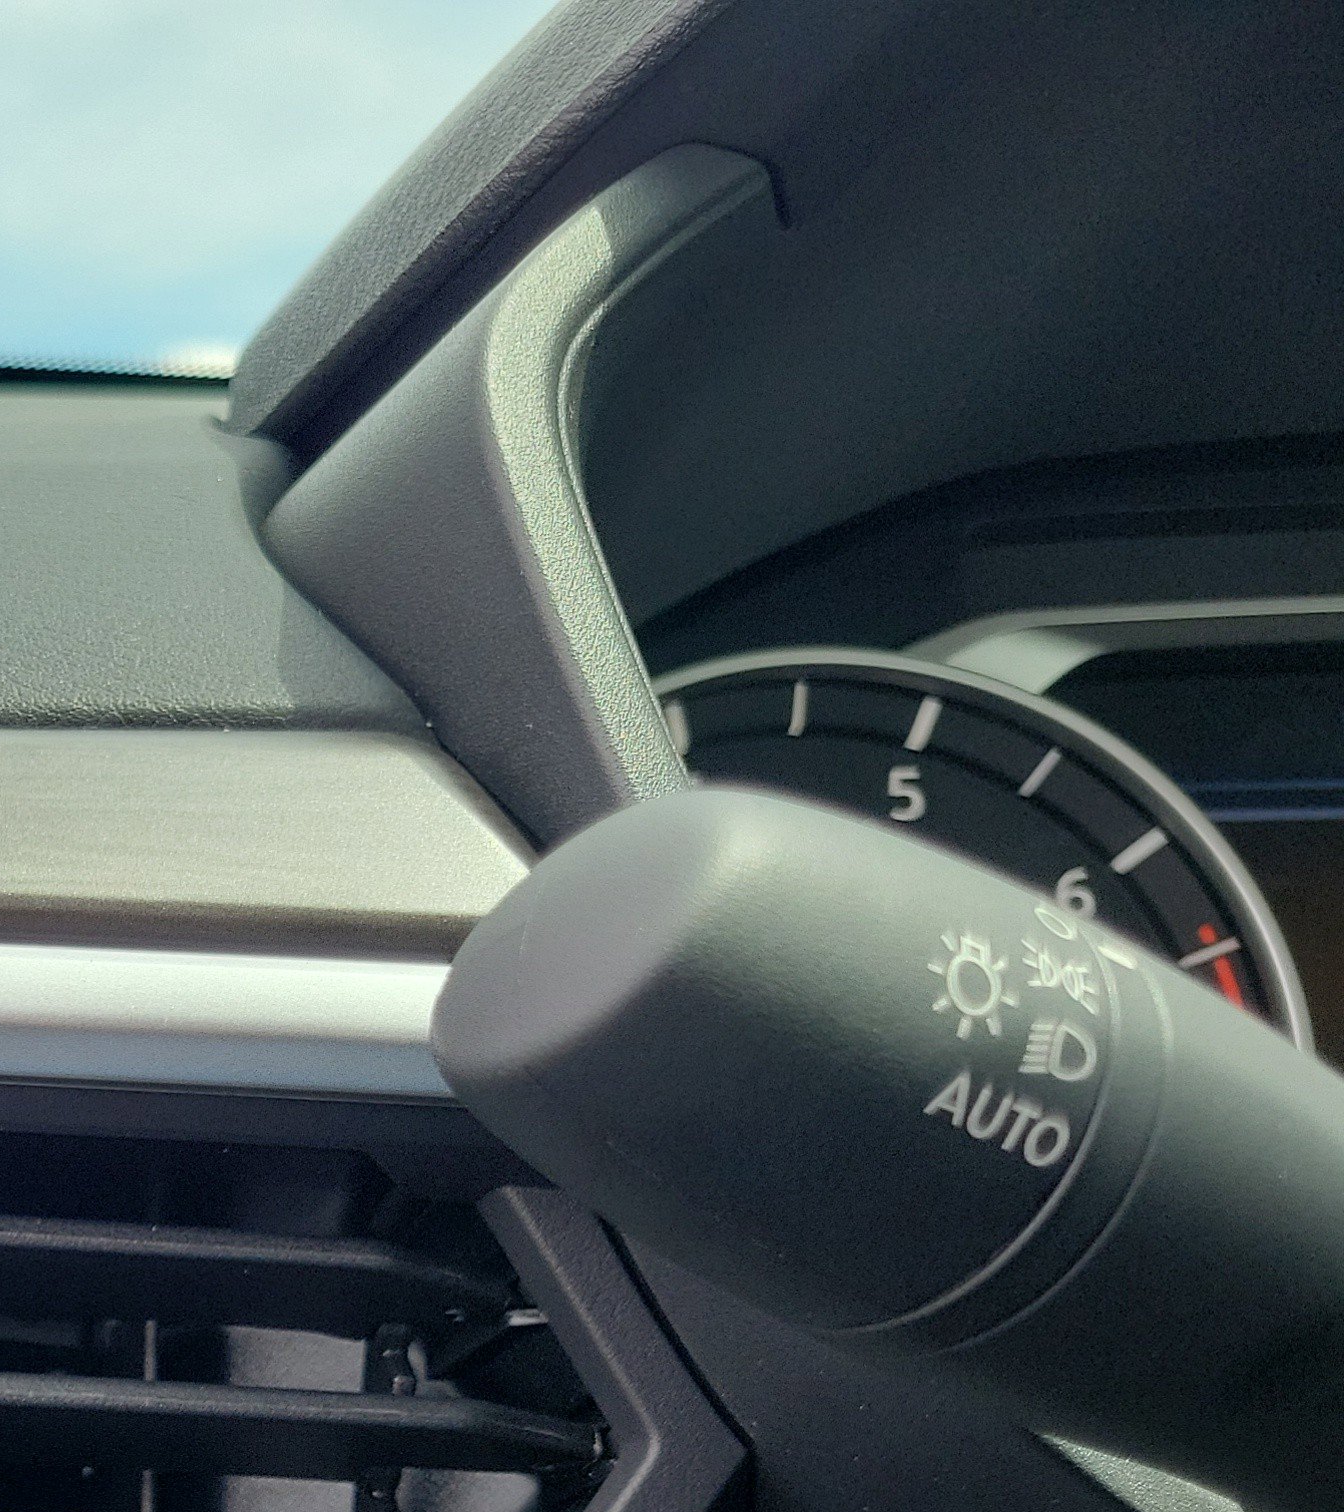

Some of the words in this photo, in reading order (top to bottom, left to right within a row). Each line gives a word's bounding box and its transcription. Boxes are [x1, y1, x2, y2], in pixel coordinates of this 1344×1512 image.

[887, 766, 926, 821] 5
[1056, 866, 1097, 917] 6
[924, 1073, 1070, 1167] AUTO
